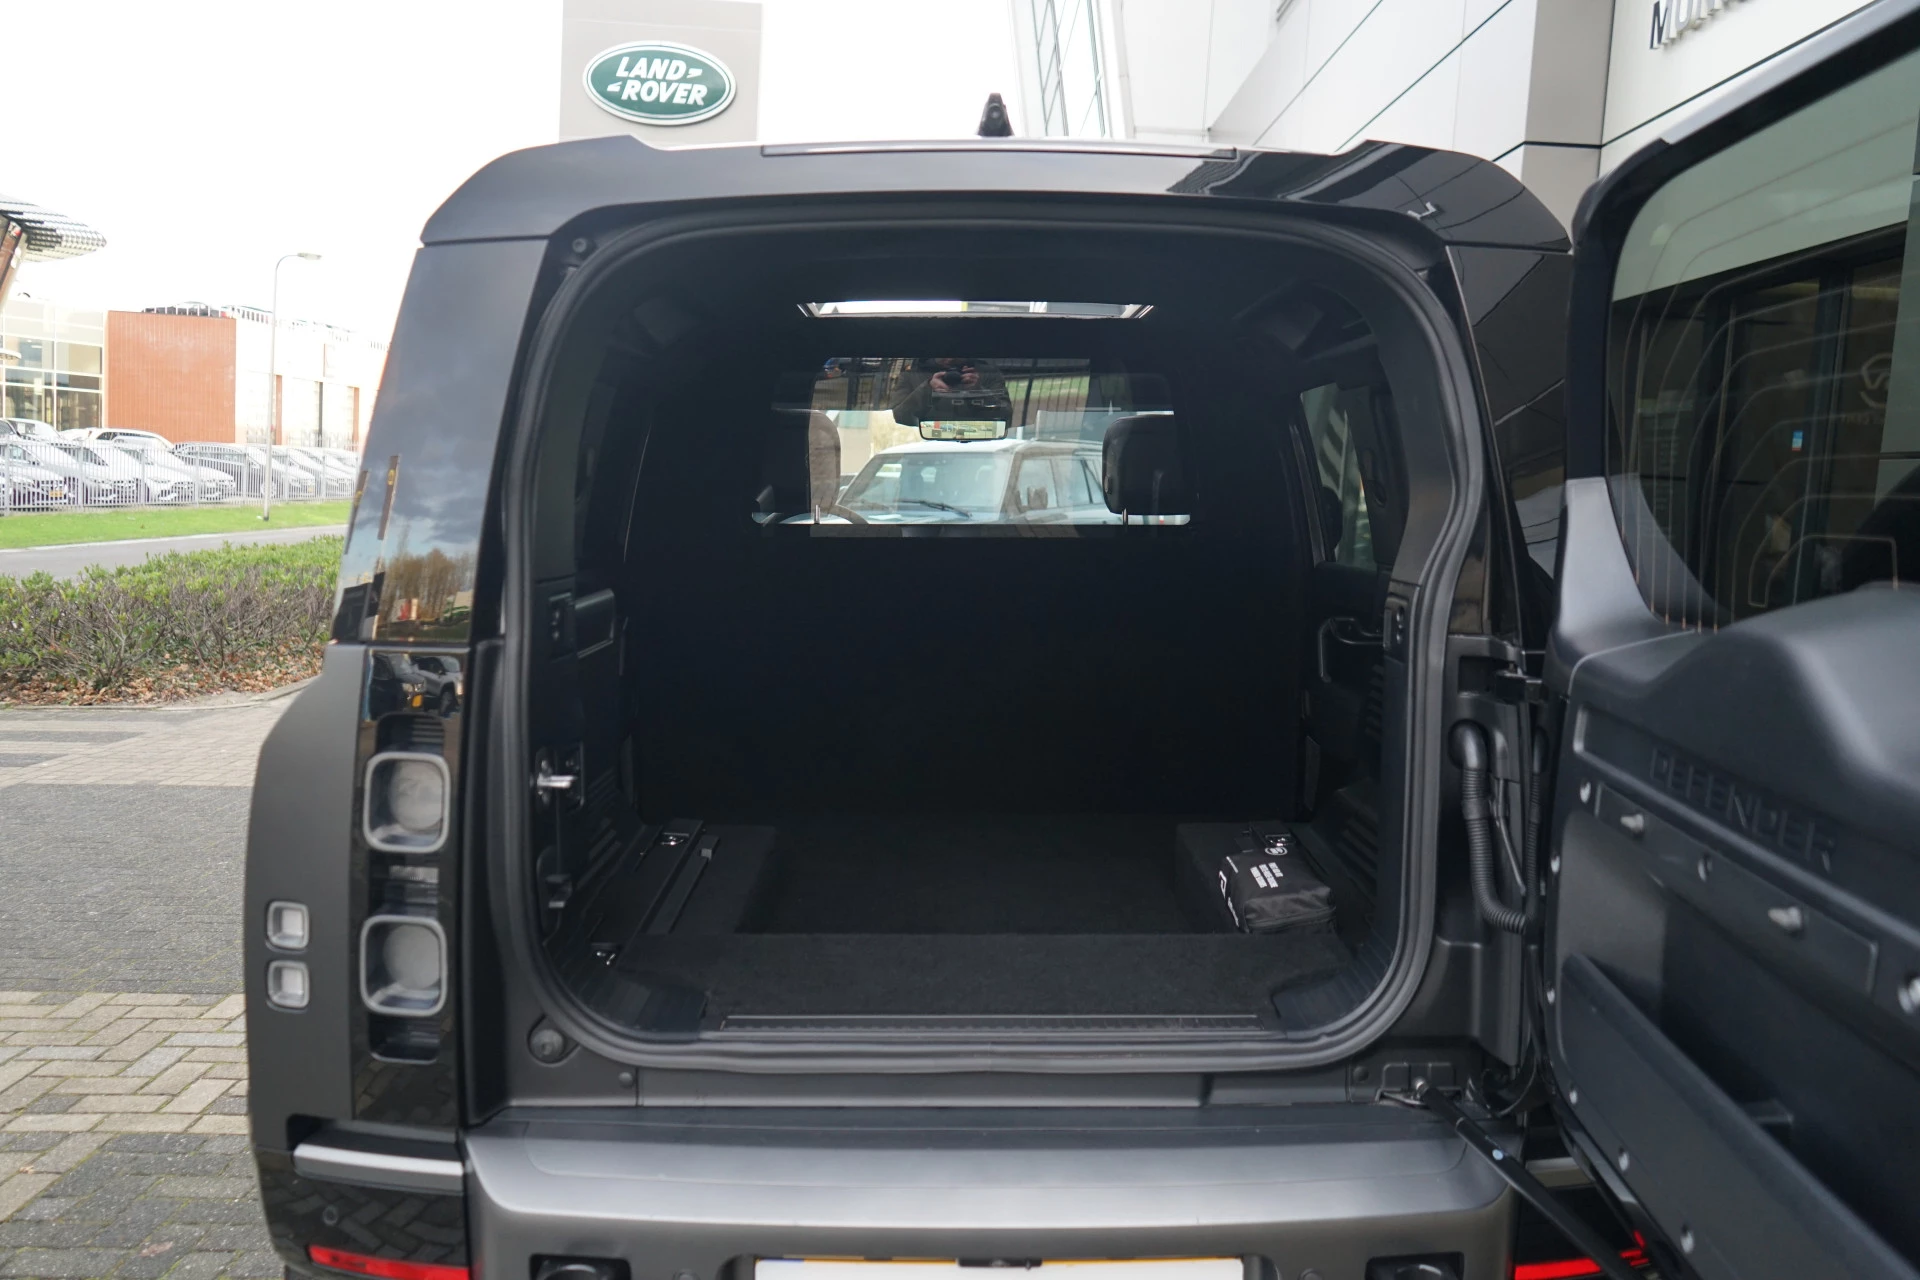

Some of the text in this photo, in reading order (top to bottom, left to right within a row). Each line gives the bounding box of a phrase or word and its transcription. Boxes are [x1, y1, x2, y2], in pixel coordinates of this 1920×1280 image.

[615, 56, 687, 81] LAND
[621, 79, 708, 106] ROVER
[1651, 747, 1837, 874] DEFENDER
